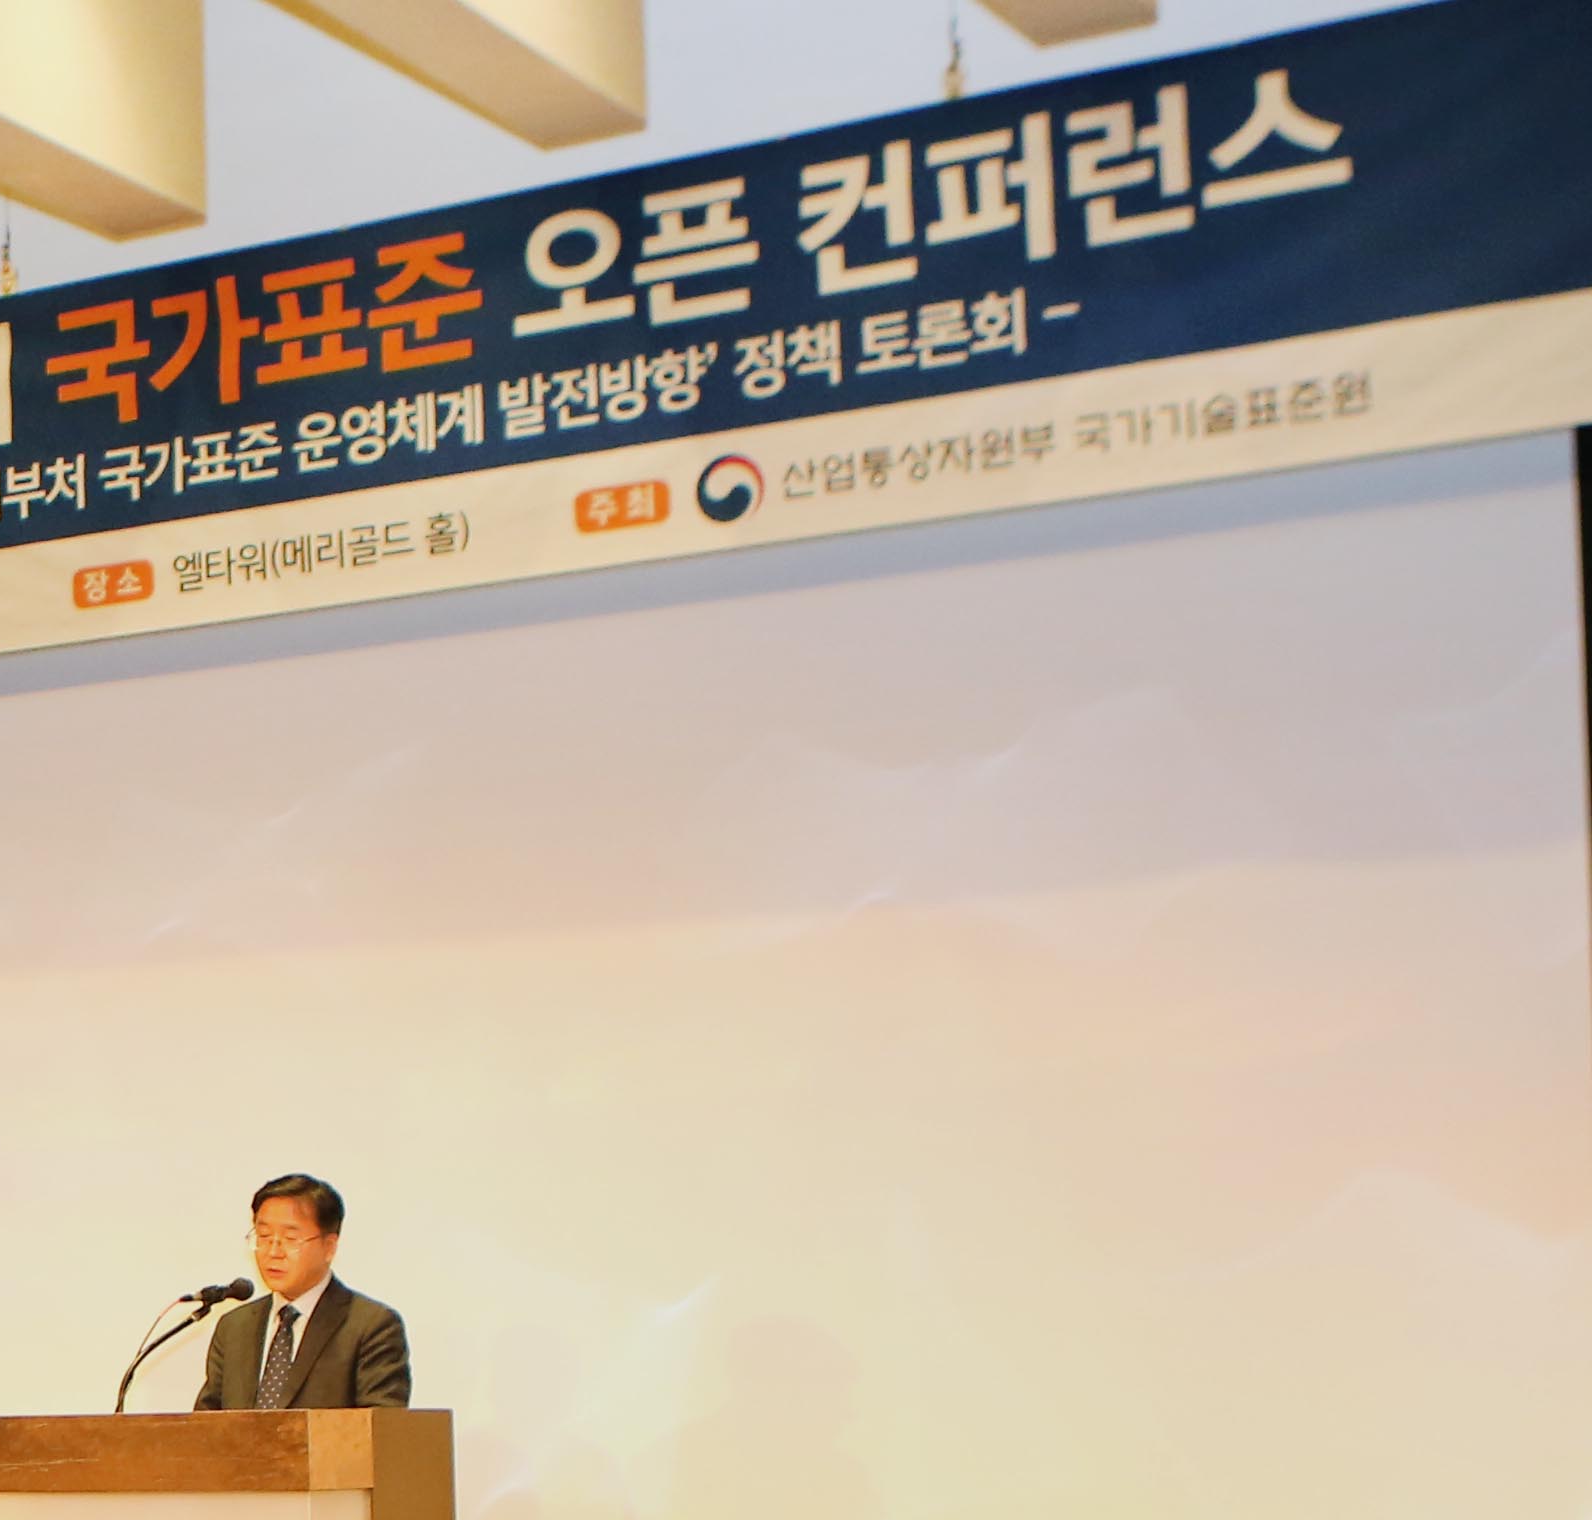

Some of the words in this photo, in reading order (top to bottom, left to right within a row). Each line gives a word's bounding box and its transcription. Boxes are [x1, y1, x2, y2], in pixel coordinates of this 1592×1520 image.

[46, 232, 483, 423] 국가표준
[512, 176, 759, 339] 오픈
[796, 68, 1353, 296] 컨퍼런스
[98, 420, 283, 501] 국가표준
[293, 383, 485, 474] 운영체계
[734, 319, 843, 399] 정책
[856, 286, 1028, 375] 토론회
[783, 421, 1056, 499] 산업통상자원부
[1076, 371, 1373, 453] 국가기술표준원
[172, 520, 416, 594] 엘타워(메리골드
[424, 510, 471, 557] 홀)
